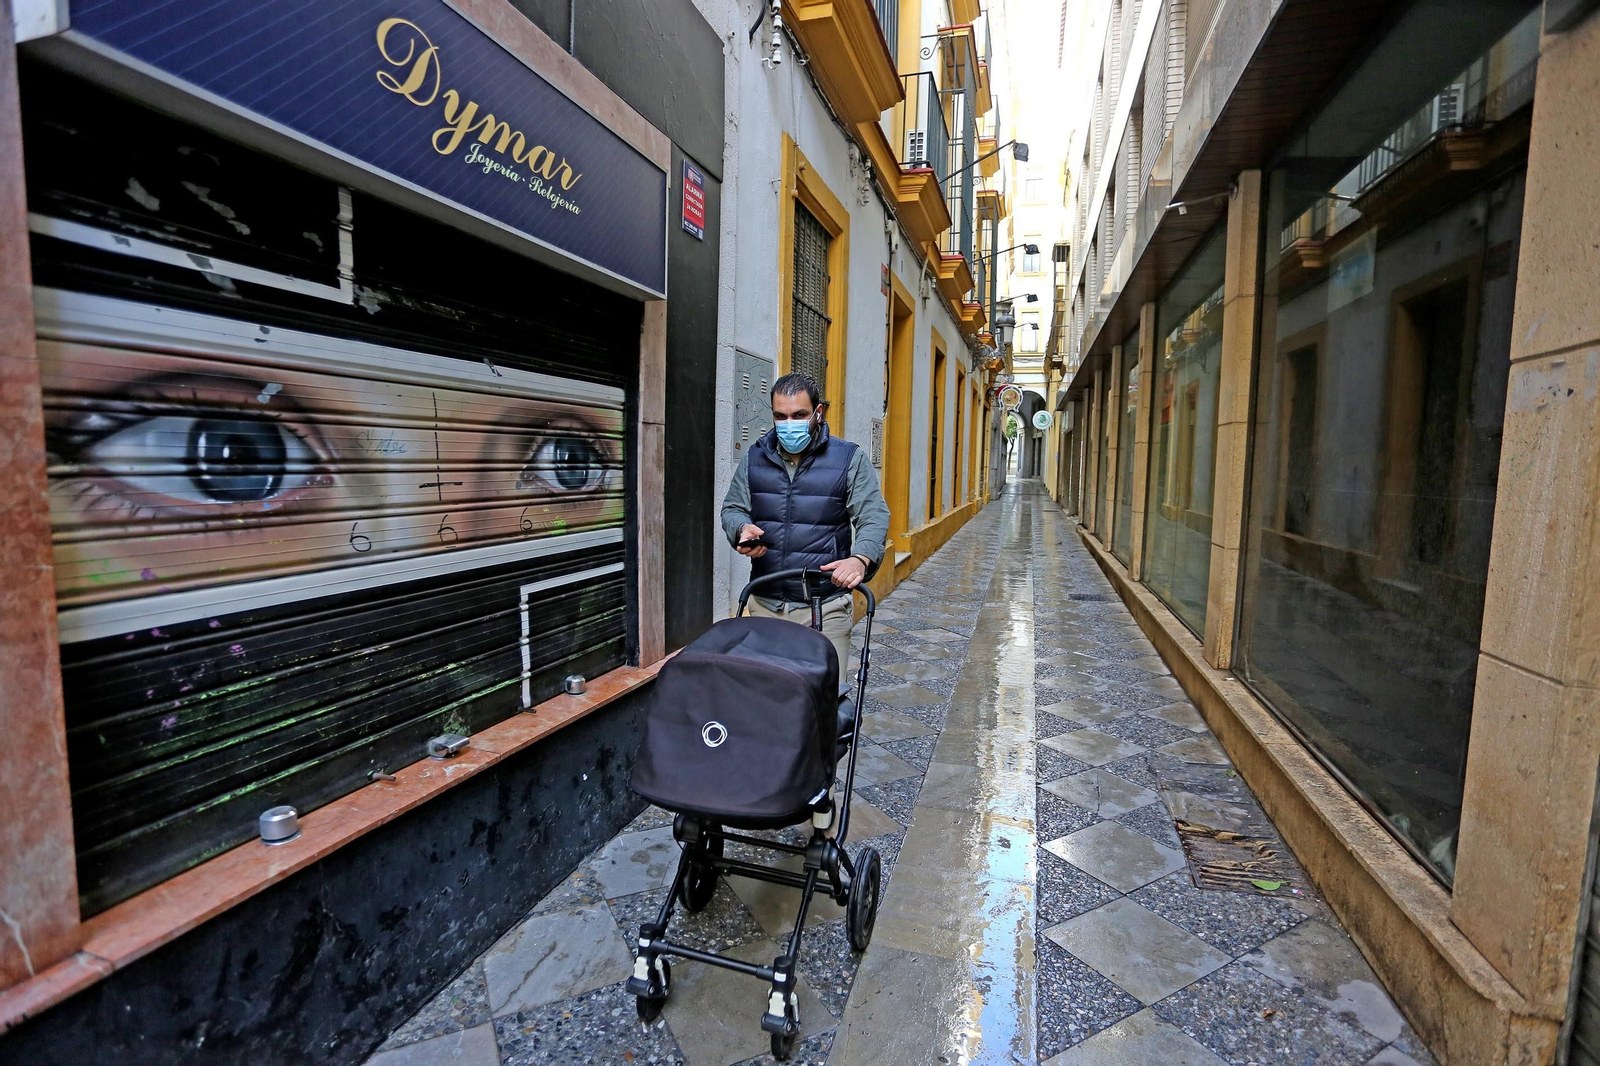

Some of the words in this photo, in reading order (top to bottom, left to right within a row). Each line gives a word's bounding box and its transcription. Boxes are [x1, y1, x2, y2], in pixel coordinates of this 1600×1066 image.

[376, 17, 583, 190] Dymar
[686, 183, 703, 200] ALARMA
[350, 521, 372, 552] 6
[437, 514, 458, 548] 6
[519, 507, 533, 532] 6
